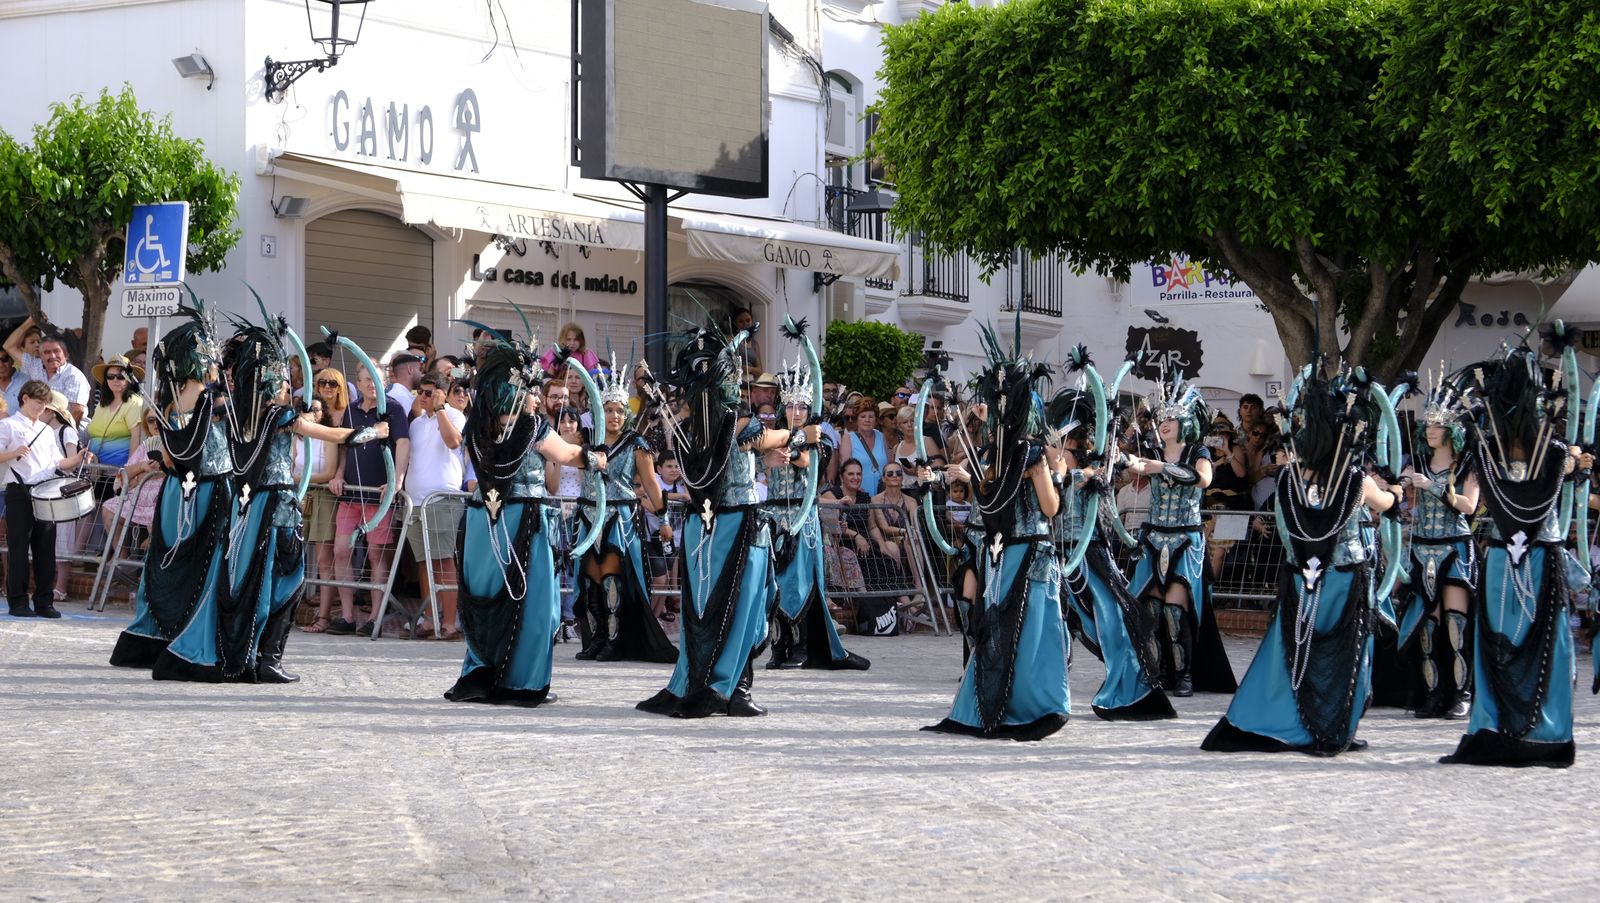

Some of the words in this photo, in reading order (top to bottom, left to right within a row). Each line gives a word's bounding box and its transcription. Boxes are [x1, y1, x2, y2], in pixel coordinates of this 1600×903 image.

[333, 90, 433, 165] GAMO
[507, 213, 605, 244] ARTESANIA
[266, 243, 271, 254] 3
[764, 243, 811, 267] GAMO
[471, 254, 497, 281] La
[504, 268, 544, 286] casa
[128, 290, 175, 302] Máximo
[1160, 291, 1197, 300] Parrilla
[127, 305, 134, 315] 2
[138, 304, 173, 315] Horas
[1270, 385, 1277, 395] 5
